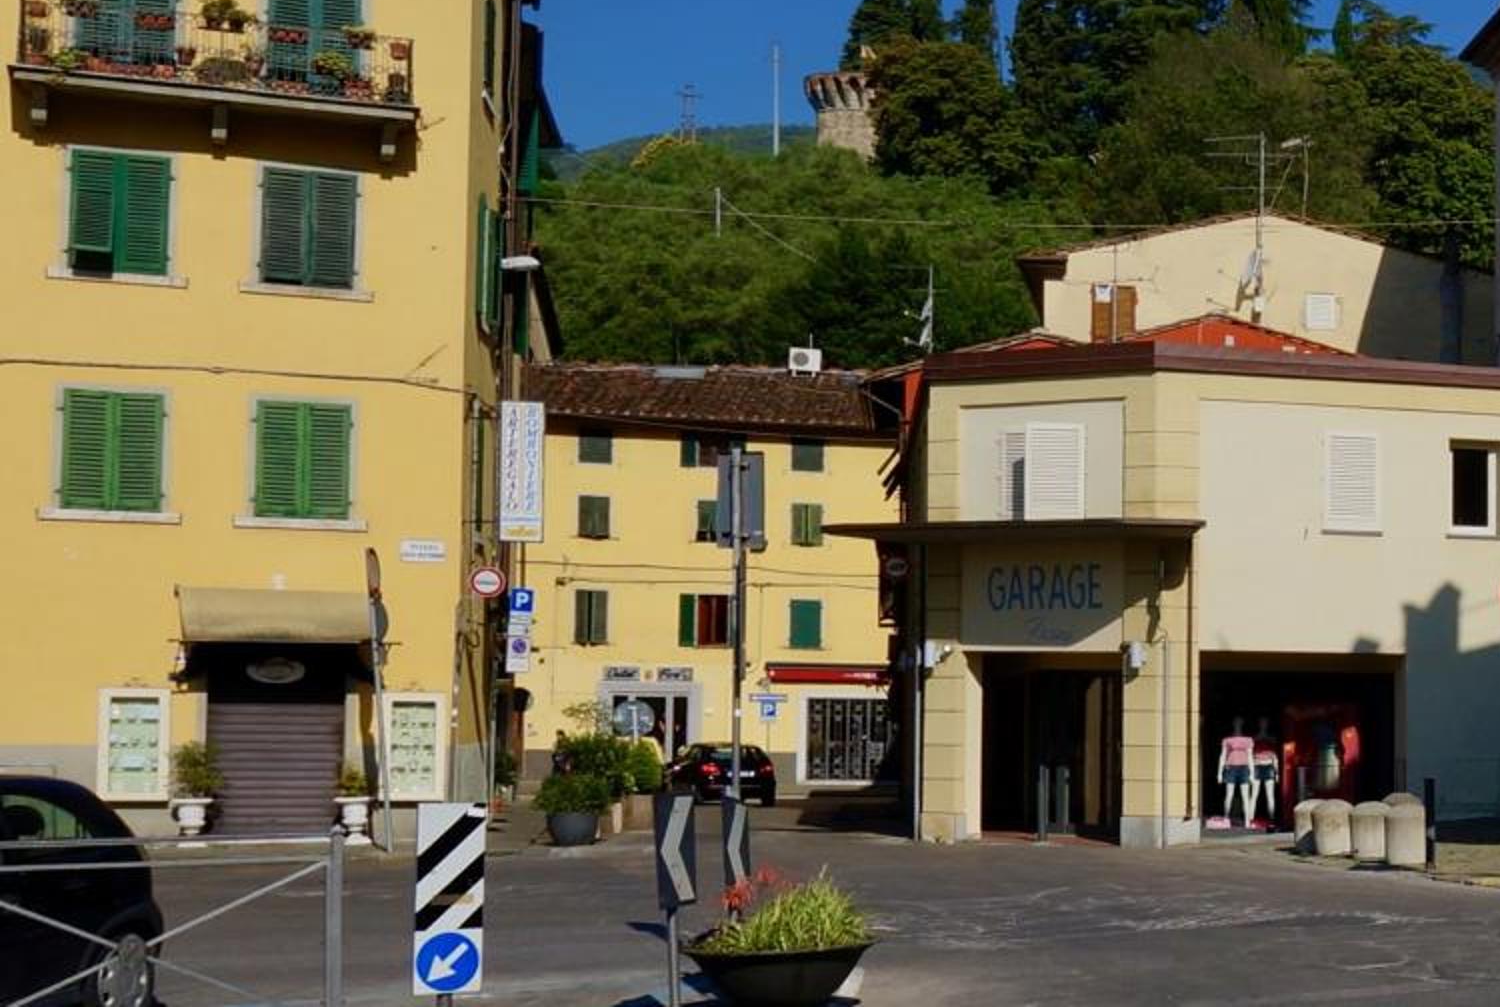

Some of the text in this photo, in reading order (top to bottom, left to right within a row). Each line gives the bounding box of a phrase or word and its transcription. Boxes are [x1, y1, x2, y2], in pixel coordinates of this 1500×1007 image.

[988, 562, 1103, 610] GARAGE
[515, 591, 529, 609] P
[763, 703, 775, 716] P
